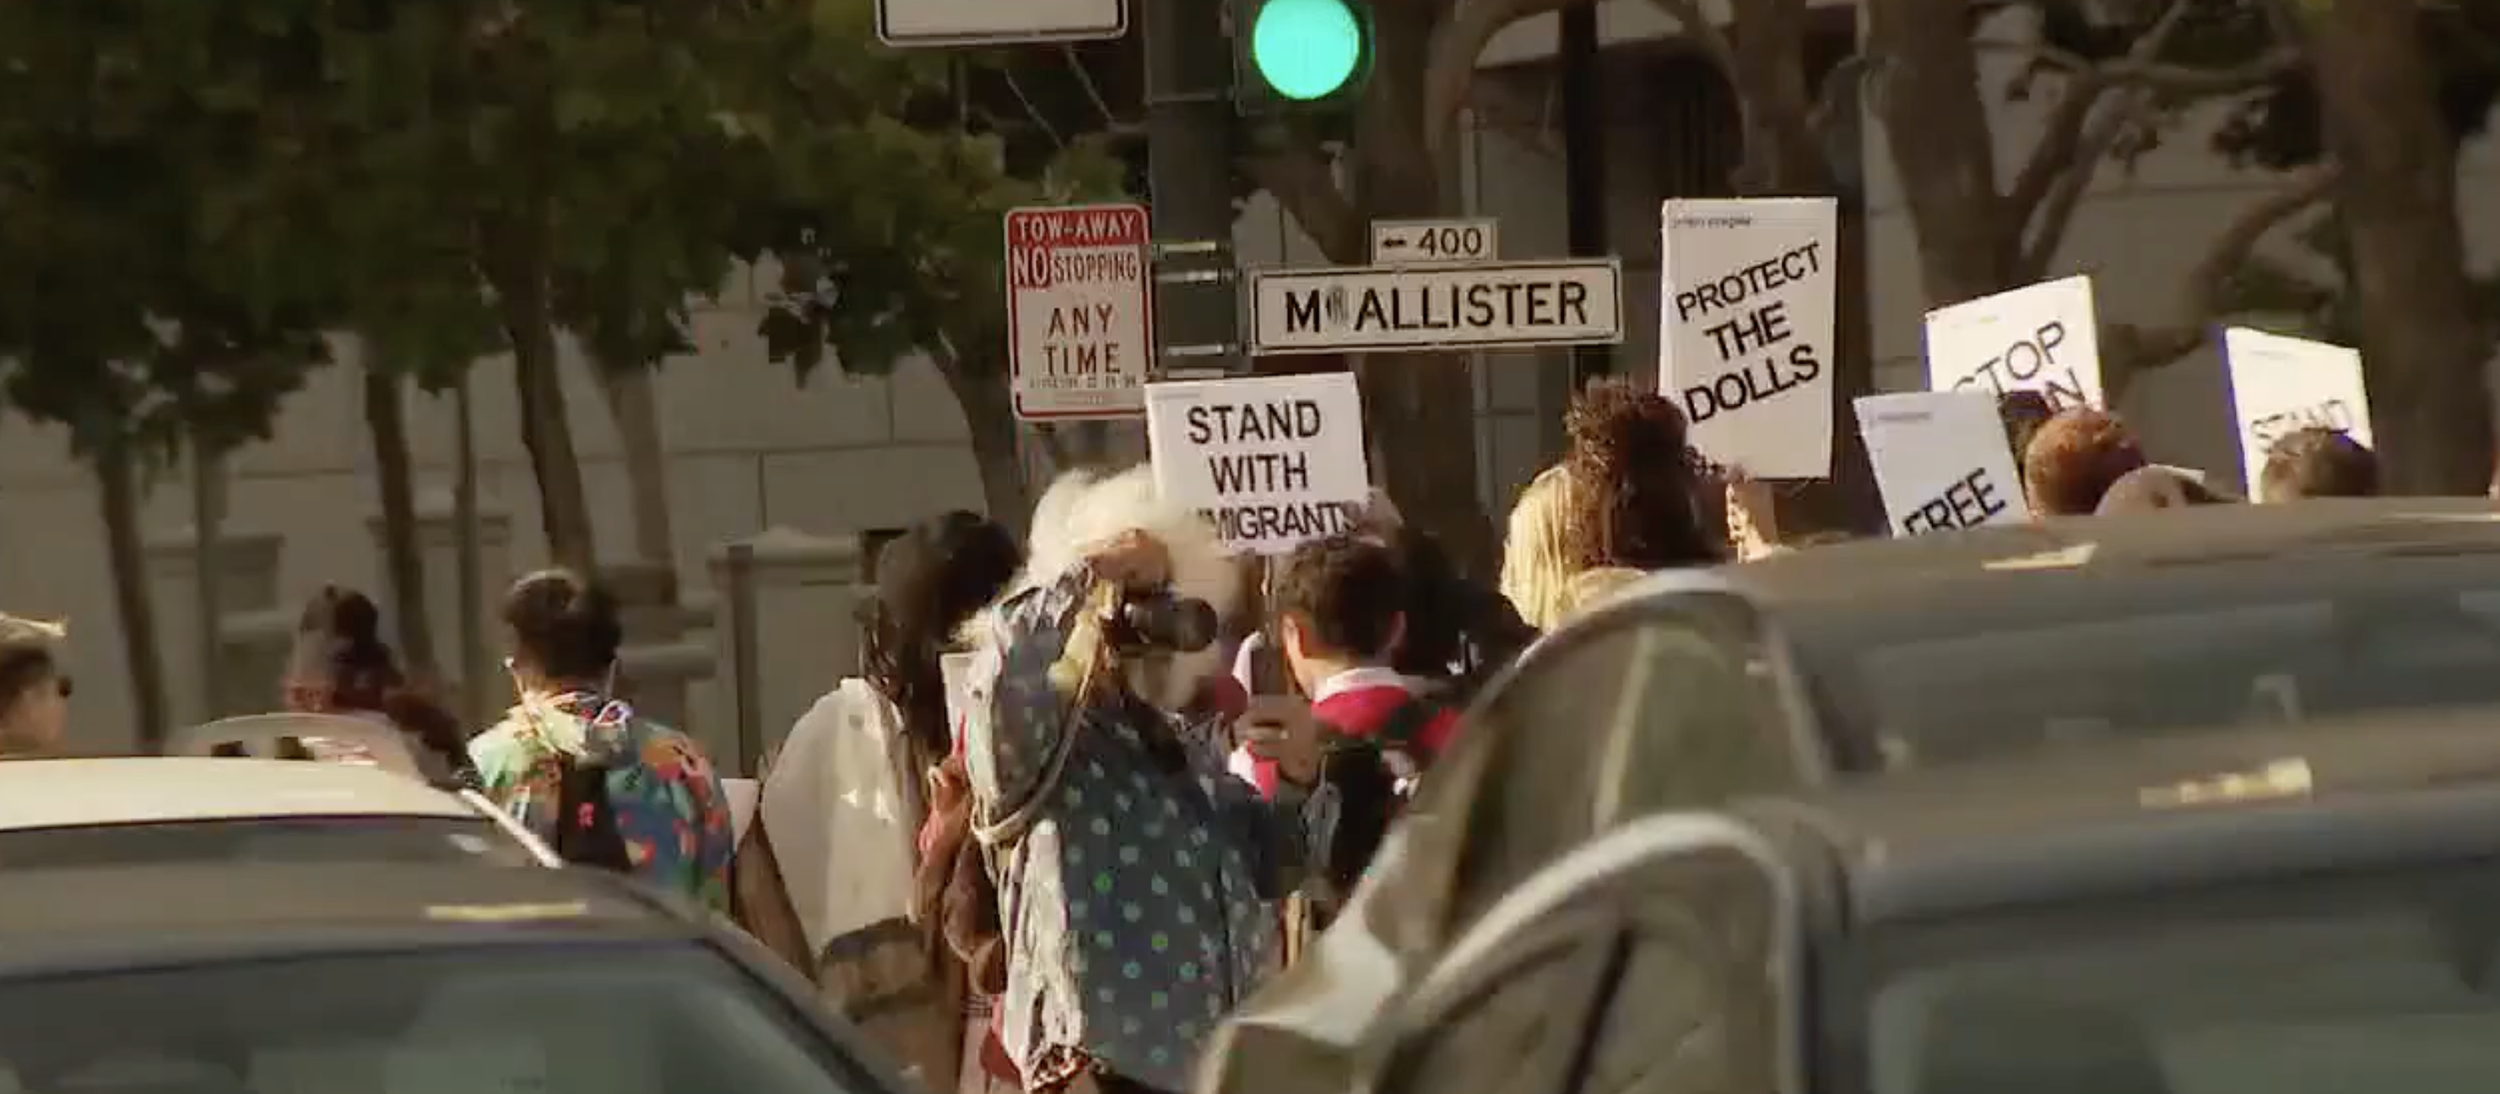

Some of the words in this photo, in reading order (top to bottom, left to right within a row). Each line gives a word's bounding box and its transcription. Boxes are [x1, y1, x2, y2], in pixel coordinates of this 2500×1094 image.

[1016, 212, 1135, 241] TOW-AWAY
[1418, 227, 1482, 255] 400
[1013, 245, 1050, 286] NO
[1053, 251, 1137, 283] STOPPING
[1675, 240, 1820, 322] PROTECT
[1048, 304, 1112, 338] ANY
[1285, 281, 1588, 333] MALLISTER
[1703, 301, 1791, 361] THE
[1042, 343, 1120, 376] TIME
[1684, 344, 1820, 424] DOLLS
[1187, 400, 1321, 444] STAND
[1209, 453, 1308, 494] WITH
[1193, 502, 1359, 541] MIGRANTS
